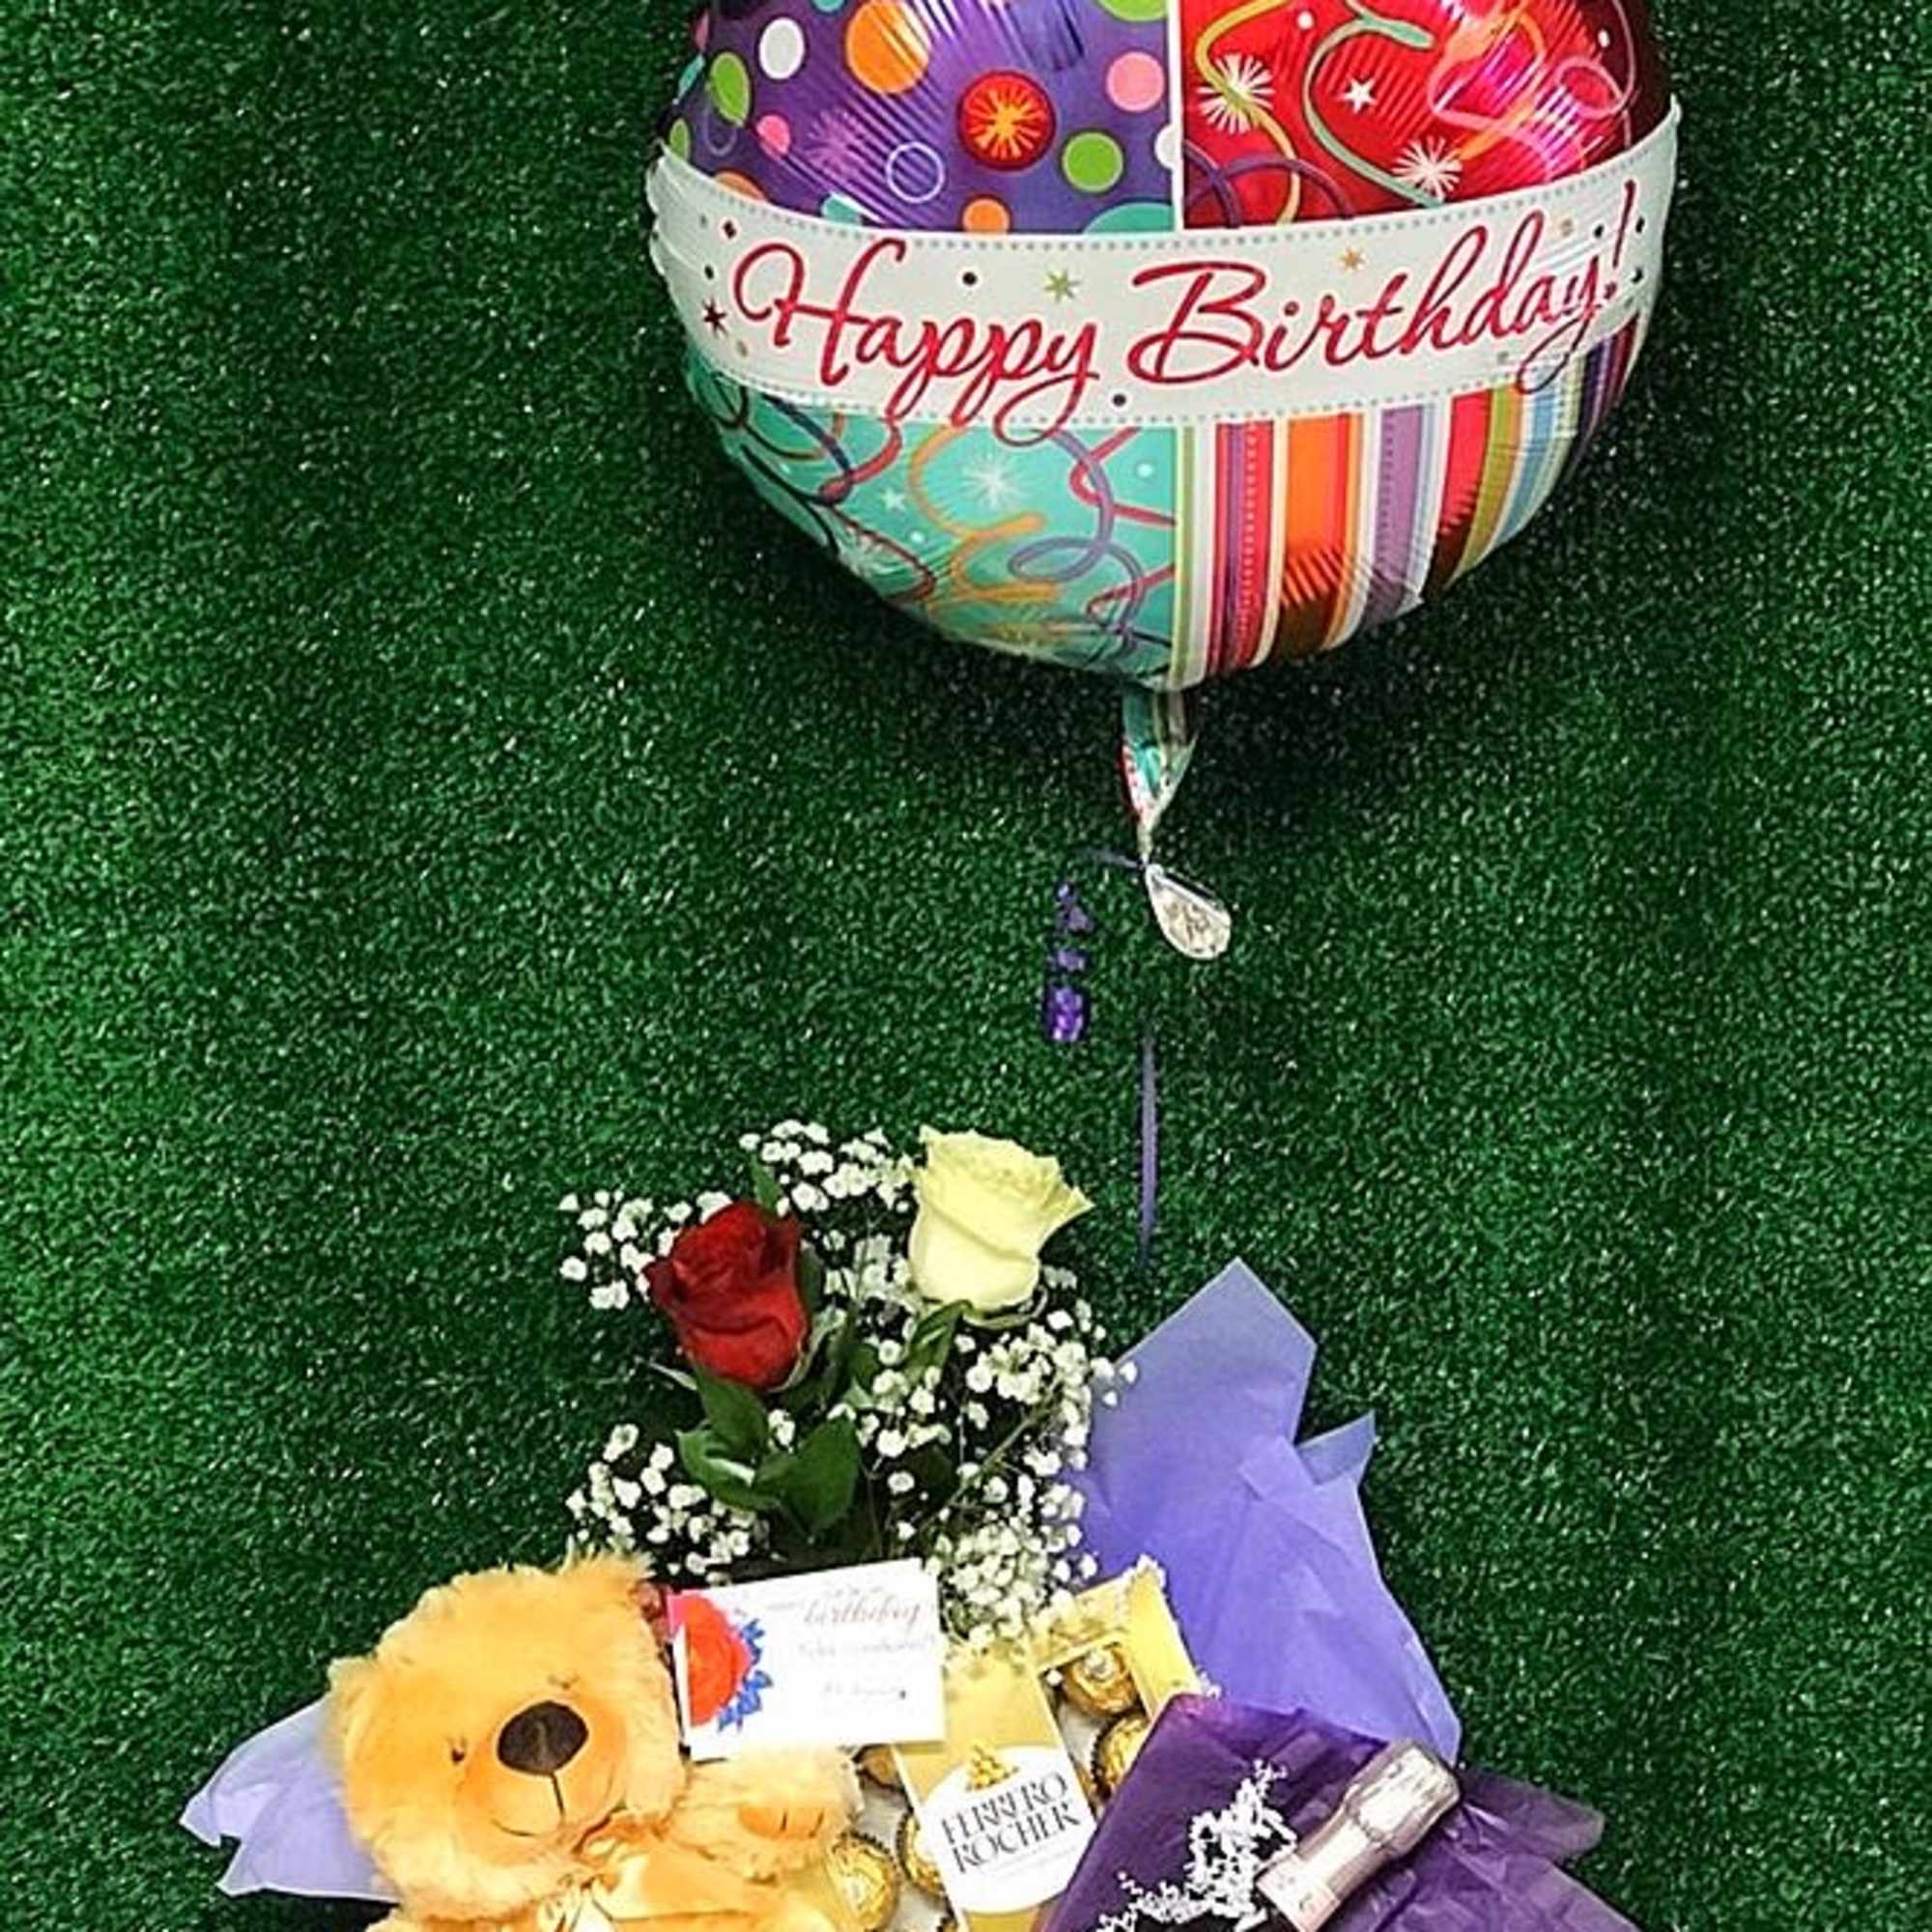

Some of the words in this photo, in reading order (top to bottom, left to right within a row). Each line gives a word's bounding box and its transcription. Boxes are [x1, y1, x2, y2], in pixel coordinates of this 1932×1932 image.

[732, 237, 1101, 447] Happy
[1125, 179, 1637, 395] Birthday!
[940, 1772, 1068, 1846] FERRERO
[952, 1802, 1081, 1874] ROCHER
